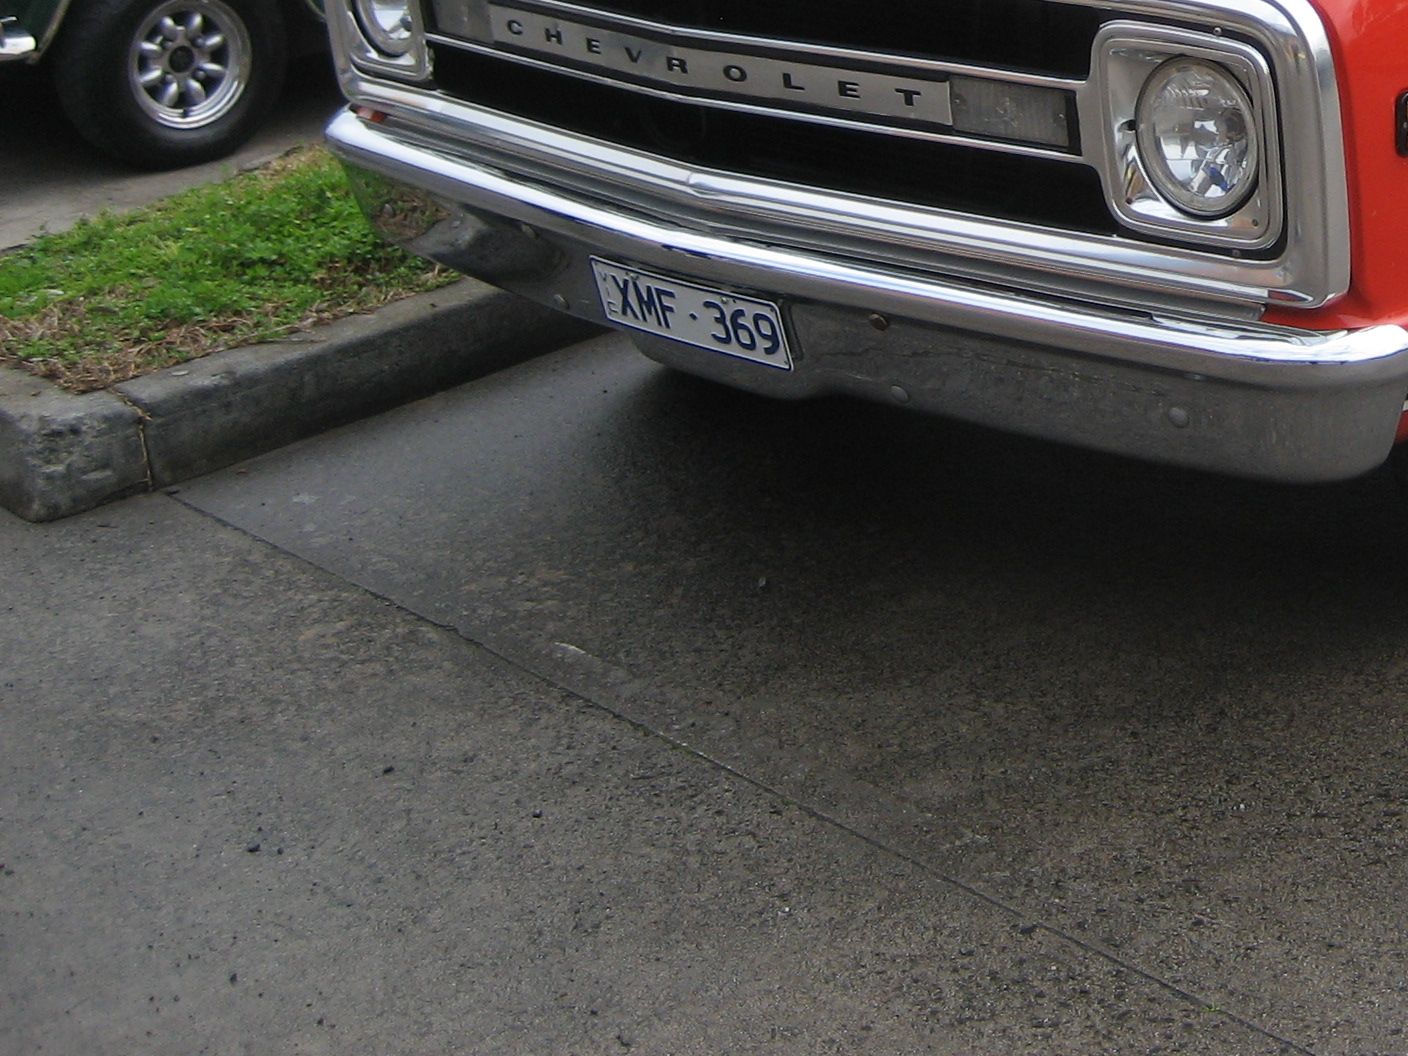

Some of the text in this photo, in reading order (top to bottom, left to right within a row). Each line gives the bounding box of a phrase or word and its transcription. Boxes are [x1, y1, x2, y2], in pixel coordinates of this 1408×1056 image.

[506, 19, 922, 107] CHEVROLET
[611, 274, 781, 356] XMF 369
